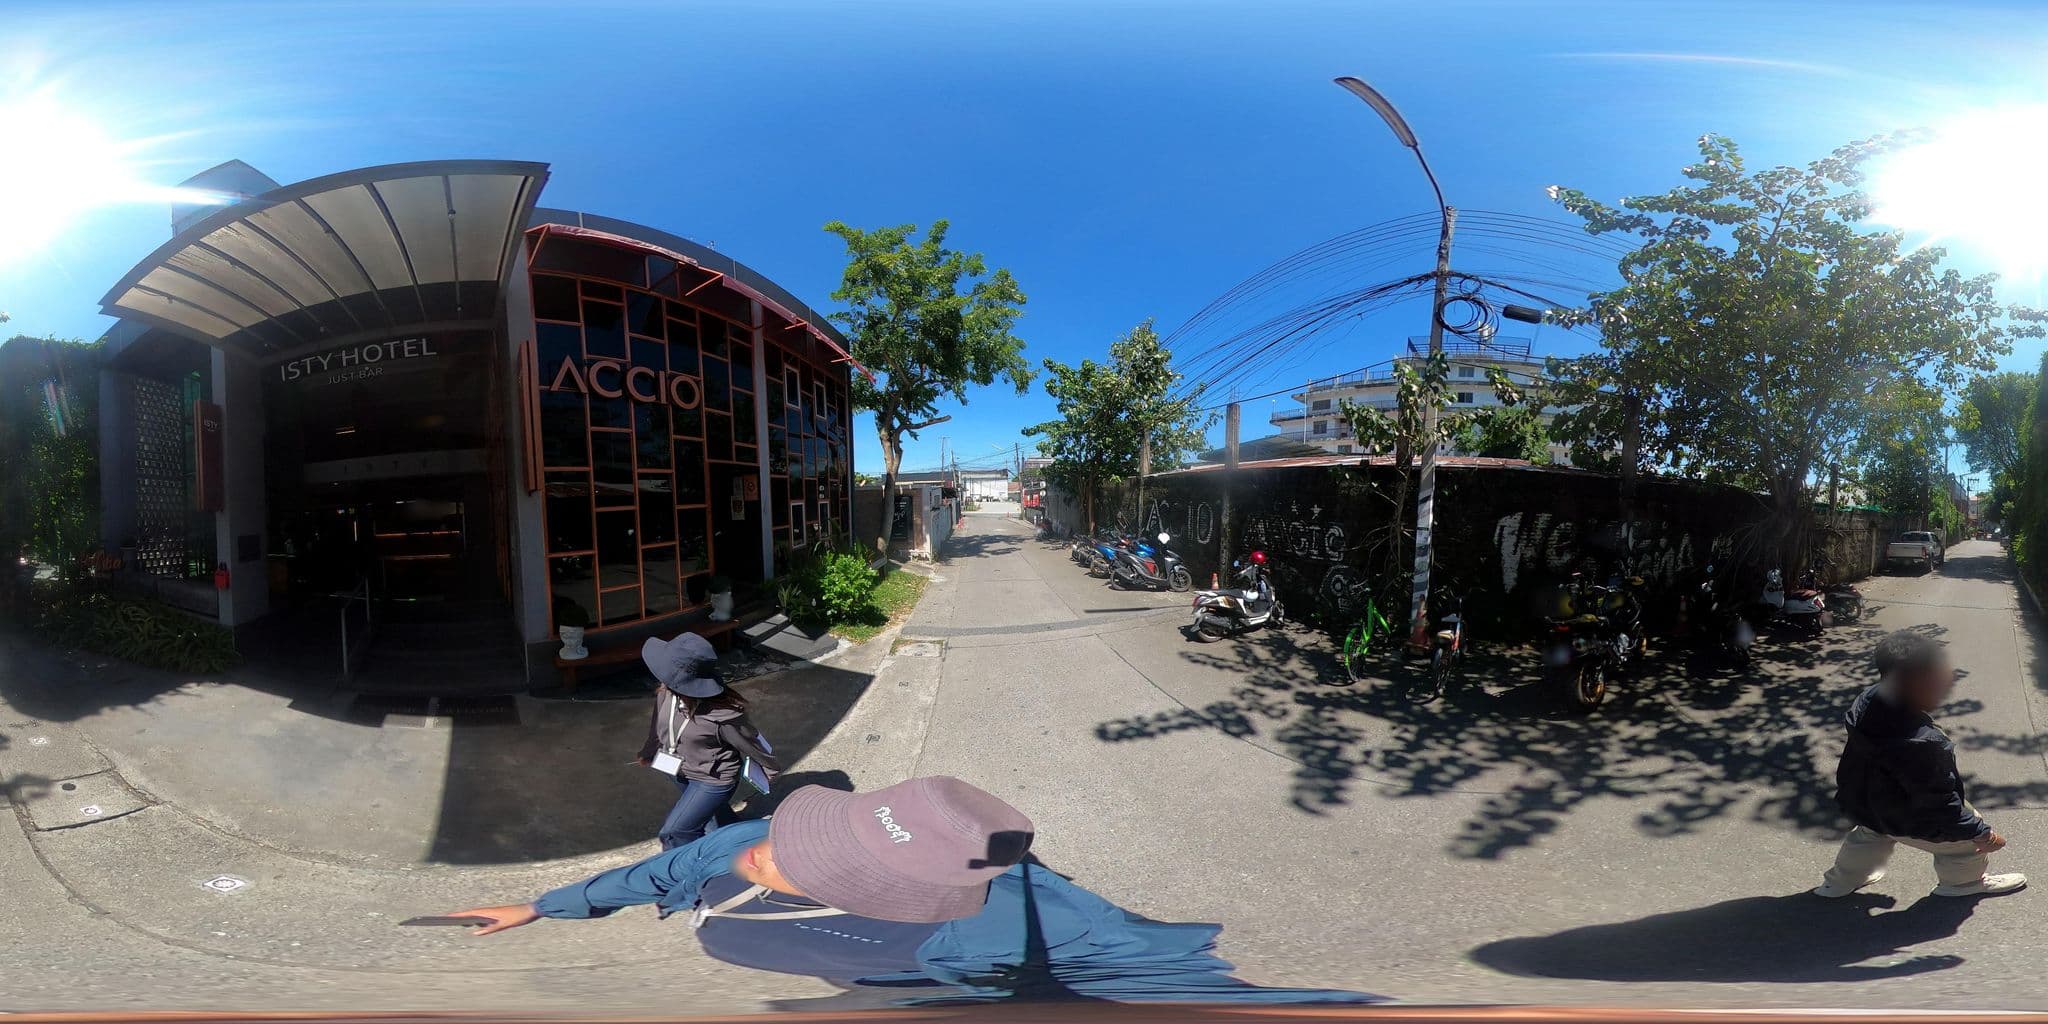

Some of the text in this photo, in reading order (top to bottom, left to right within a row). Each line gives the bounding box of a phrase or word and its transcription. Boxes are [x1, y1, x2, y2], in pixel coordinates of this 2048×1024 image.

[280, 338, 438, 382] ISTY HOTEL
[328, 367, 384, 385] JUST BAR
[550, 355, 701, 410] ACCIO
